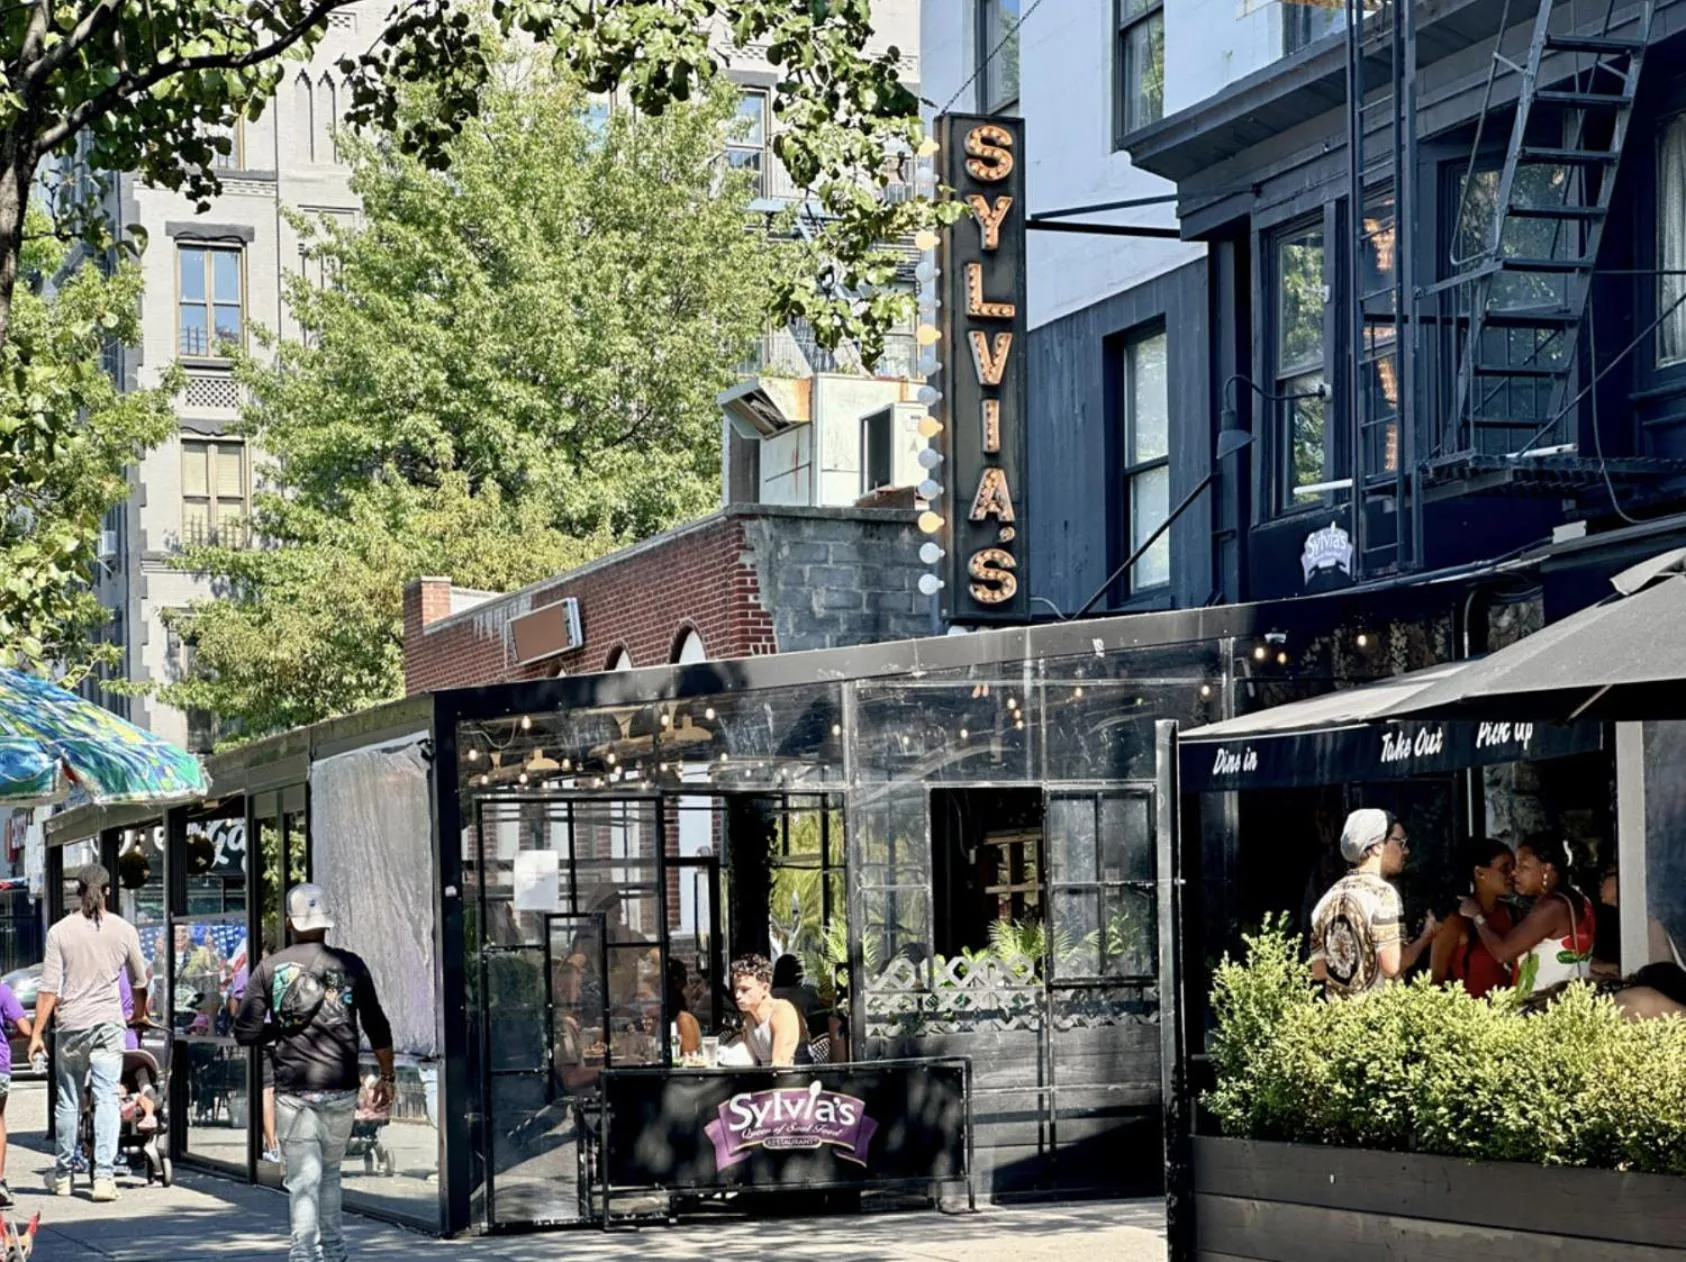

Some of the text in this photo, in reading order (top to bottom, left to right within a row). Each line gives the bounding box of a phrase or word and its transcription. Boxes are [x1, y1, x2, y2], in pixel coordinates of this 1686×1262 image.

[964, 124, 1017, 604] SYLVIA'S
[1380, 727, 1443, 763] Take Out
[1476, 721, 1511, 749] Pick
[1213, 746, 1258, 775] Dine in
[728, 1080, 856, 1132] Sylvia's
[772, 1123, 787, 1134] of
